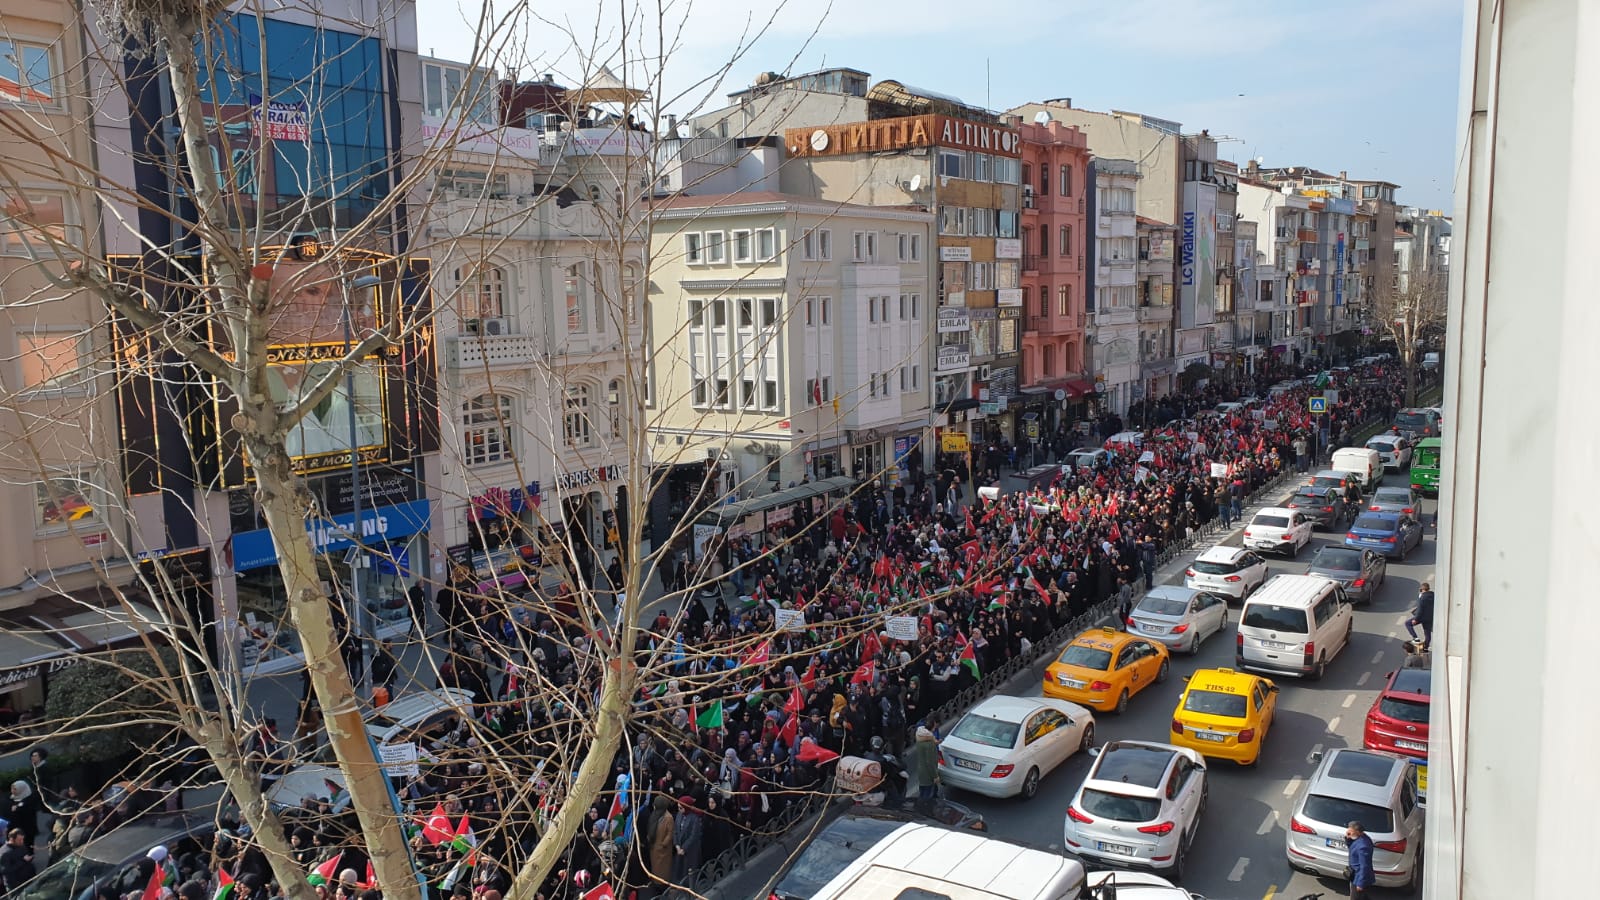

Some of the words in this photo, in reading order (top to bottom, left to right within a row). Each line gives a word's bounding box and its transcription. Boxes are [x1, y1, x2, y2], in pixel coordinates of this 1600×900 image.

[1182, 267, 1193, 286] LC
[940, 318, 967, 328] EMLAK
[940, 354, 967, 366] EMLAK
